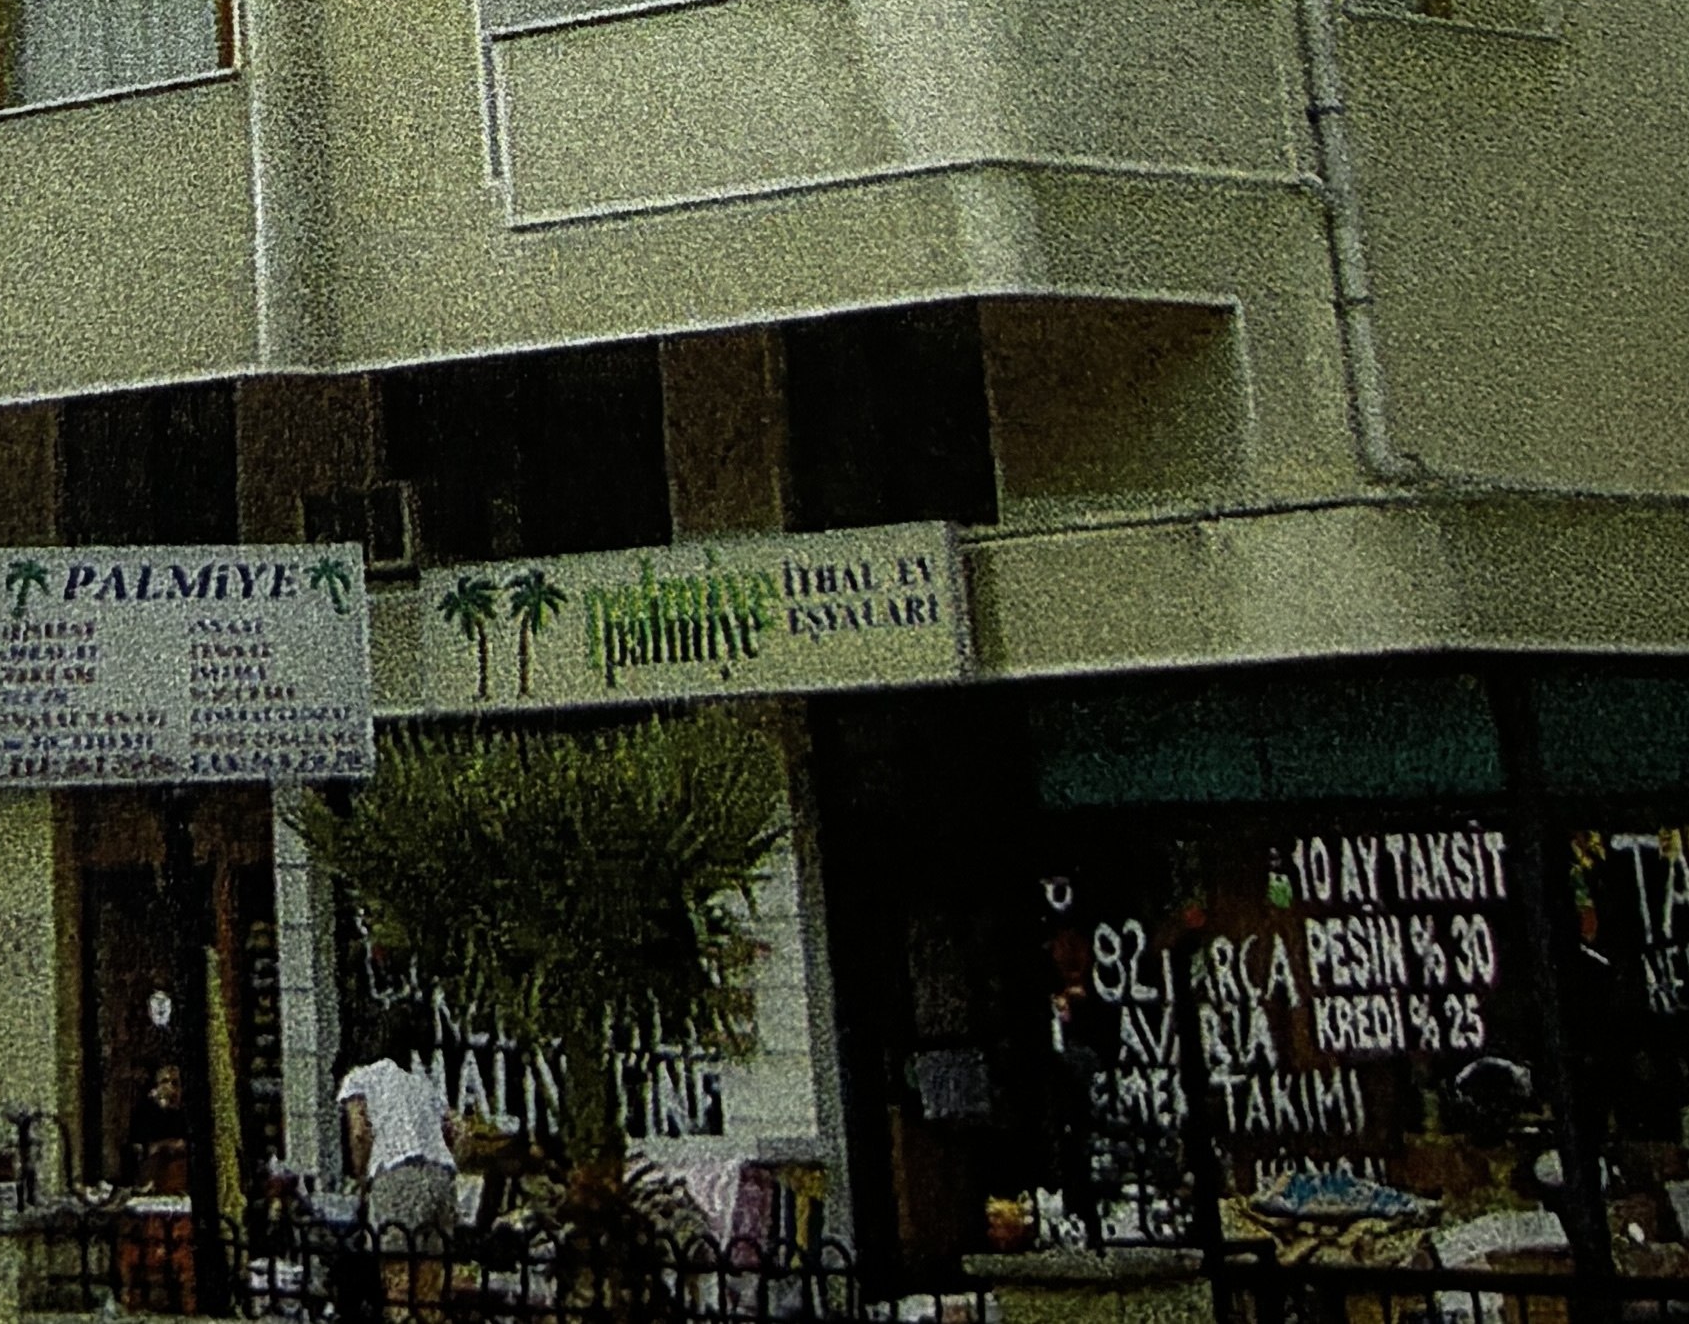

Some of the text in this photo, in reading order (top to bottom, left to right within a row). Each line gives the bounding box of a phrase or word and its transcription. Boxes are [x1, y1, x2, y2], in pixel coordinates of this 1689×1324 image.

[1292, 819, 1508, 902] 10 AY TAKSİT
[1092, 917, 1158, 1002] 82
[1409, 913, 1447, 986] %
[1450, 913, 1495, 985] 30
[1314, 987, 1485, 1050] KREDİ % 25
